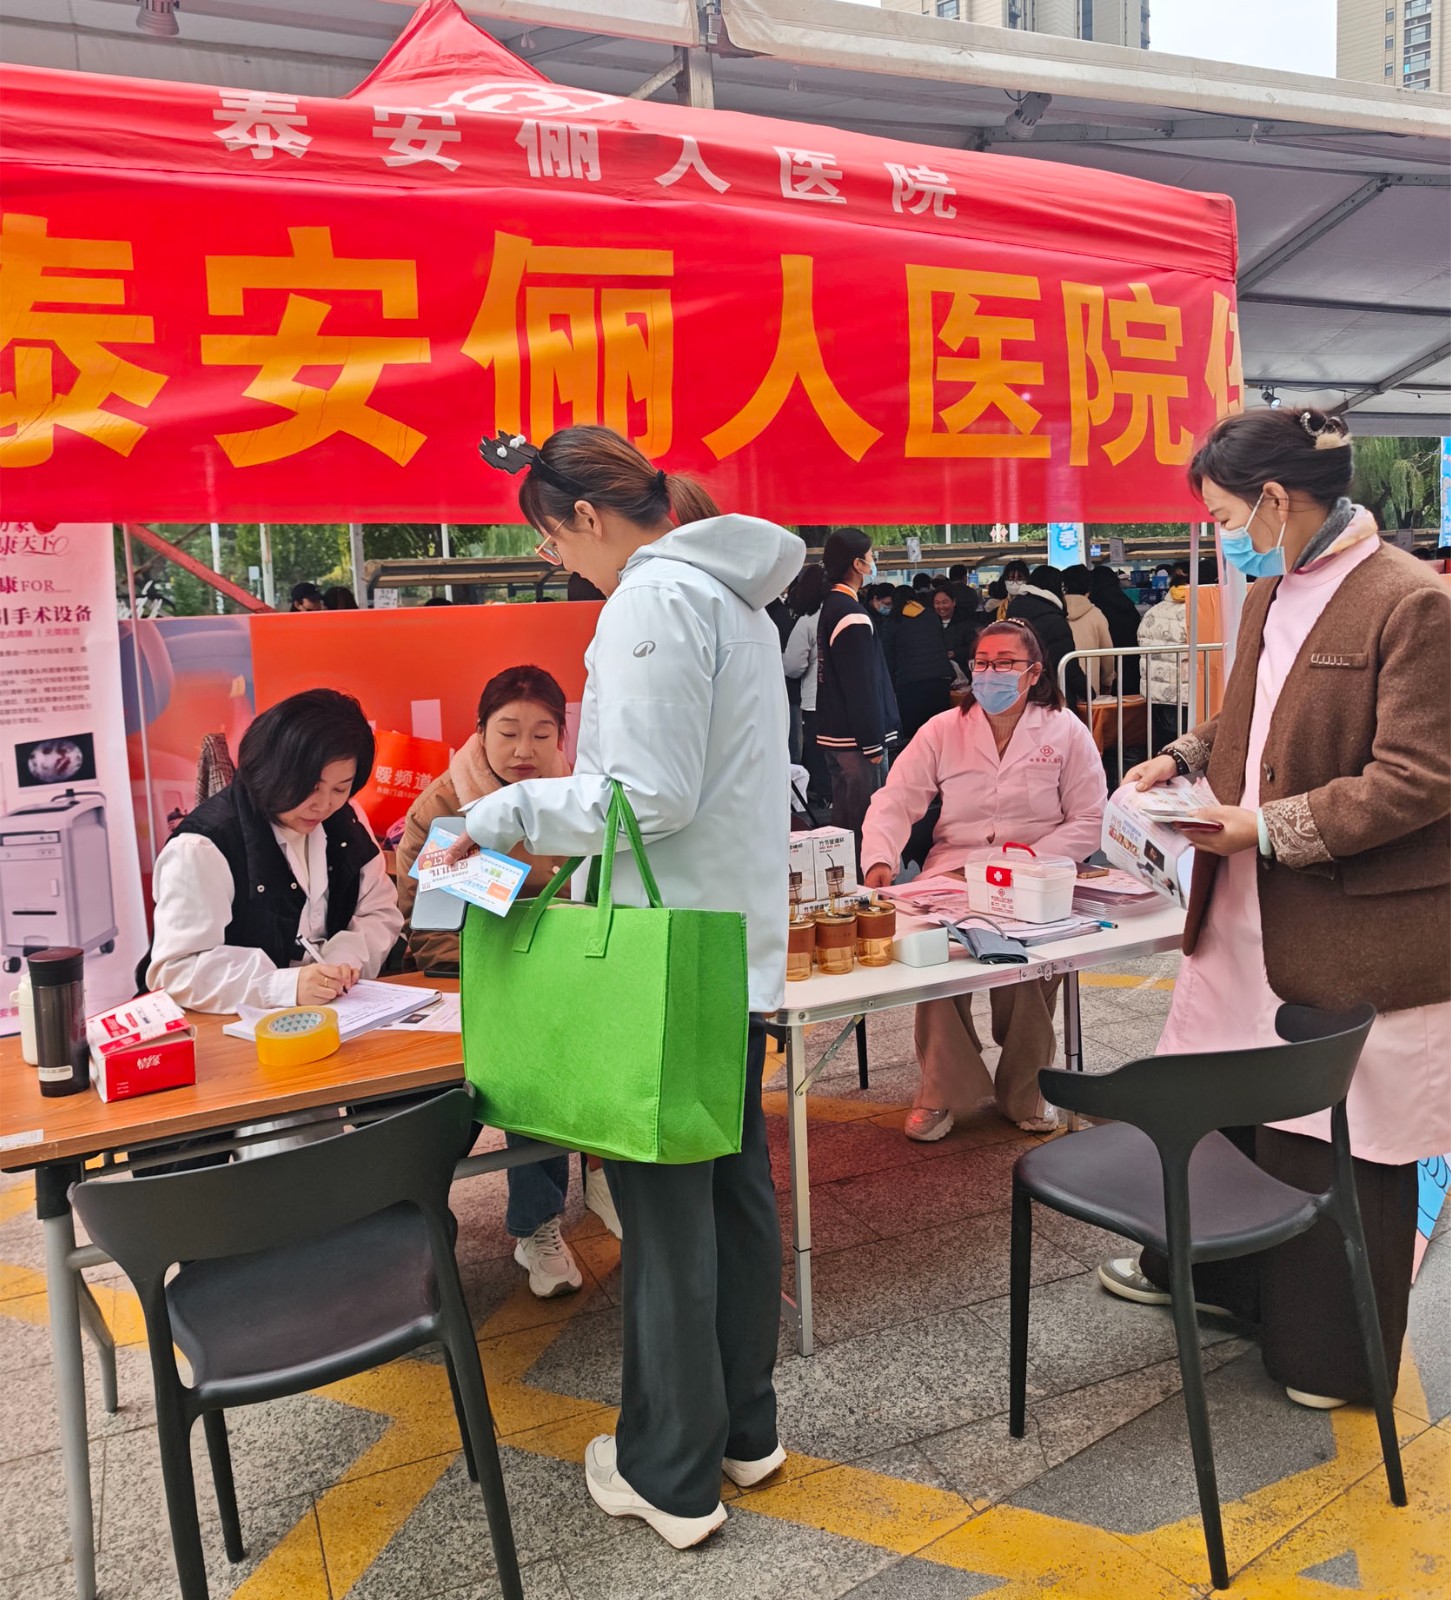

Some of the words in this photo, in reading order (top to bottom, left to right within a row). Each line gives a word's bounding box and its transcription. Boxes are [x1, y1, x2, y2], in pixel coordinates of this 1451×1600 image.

[212, 89, 959, 220] 泰安俪人医院
[21, 579, 55, 592] FOR
